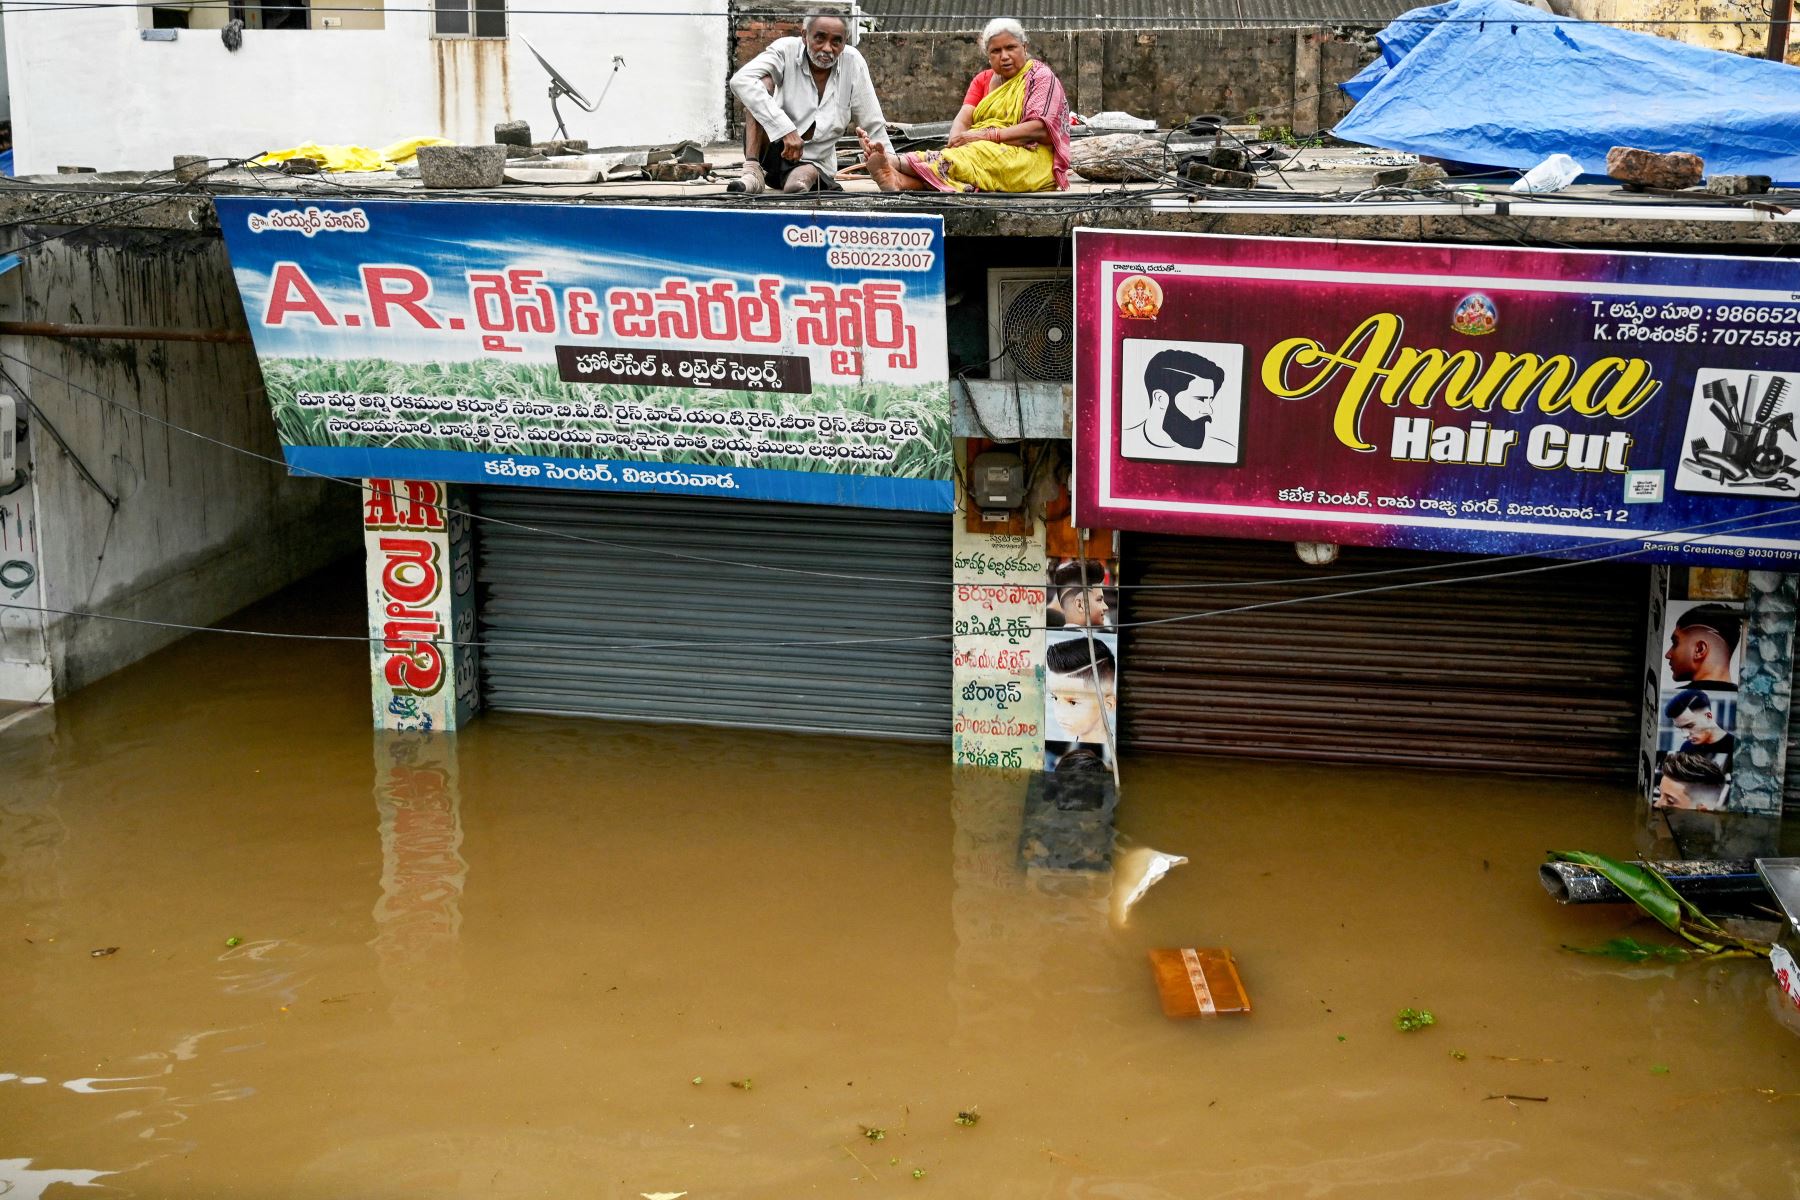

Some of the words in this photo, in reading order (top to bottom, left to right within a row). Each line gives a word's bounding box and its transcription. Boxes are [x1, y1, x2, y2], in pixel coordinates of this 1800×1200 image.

[787, 228, 823, 243] Cell:
[829, 230, 931, 247] 7989687007
[830, 251, 932, 268] 8500223007
[1590, 300, 1604, 318] T.
[265, 264, 466, 330] A.R.
[469, 269, 556, 353] రైస్
[568, 290, 600, 336] &
[609, 278, 782, 344] జనరల్
[793, 282, 918, 377] స్టోర్స్
[1593, 323, 1612, 341] K.
[661, 363, 675, 377] &
[678, 358, 727, 387] రిటైల్
[729, 361, 783, 389] సెల్లర్స్
[1261, 312, 1660, 451] Amma
[298, 393, 325, 407] మా
[328, 395, 356, 411] వద్ద
[358, 395, 391, 413] అన్ని
[527, 428, 592, 443] మరియు
[673, 434, 708, 449] పాత
[1390, 416, 1515, 466] Hair
[1526, 422, 1632, 473] Cut
[364, 478, 446, 532] A.R
[1377, 495, 1416, 509] రామ
[1747, 549, 1800, 561] 90301091
